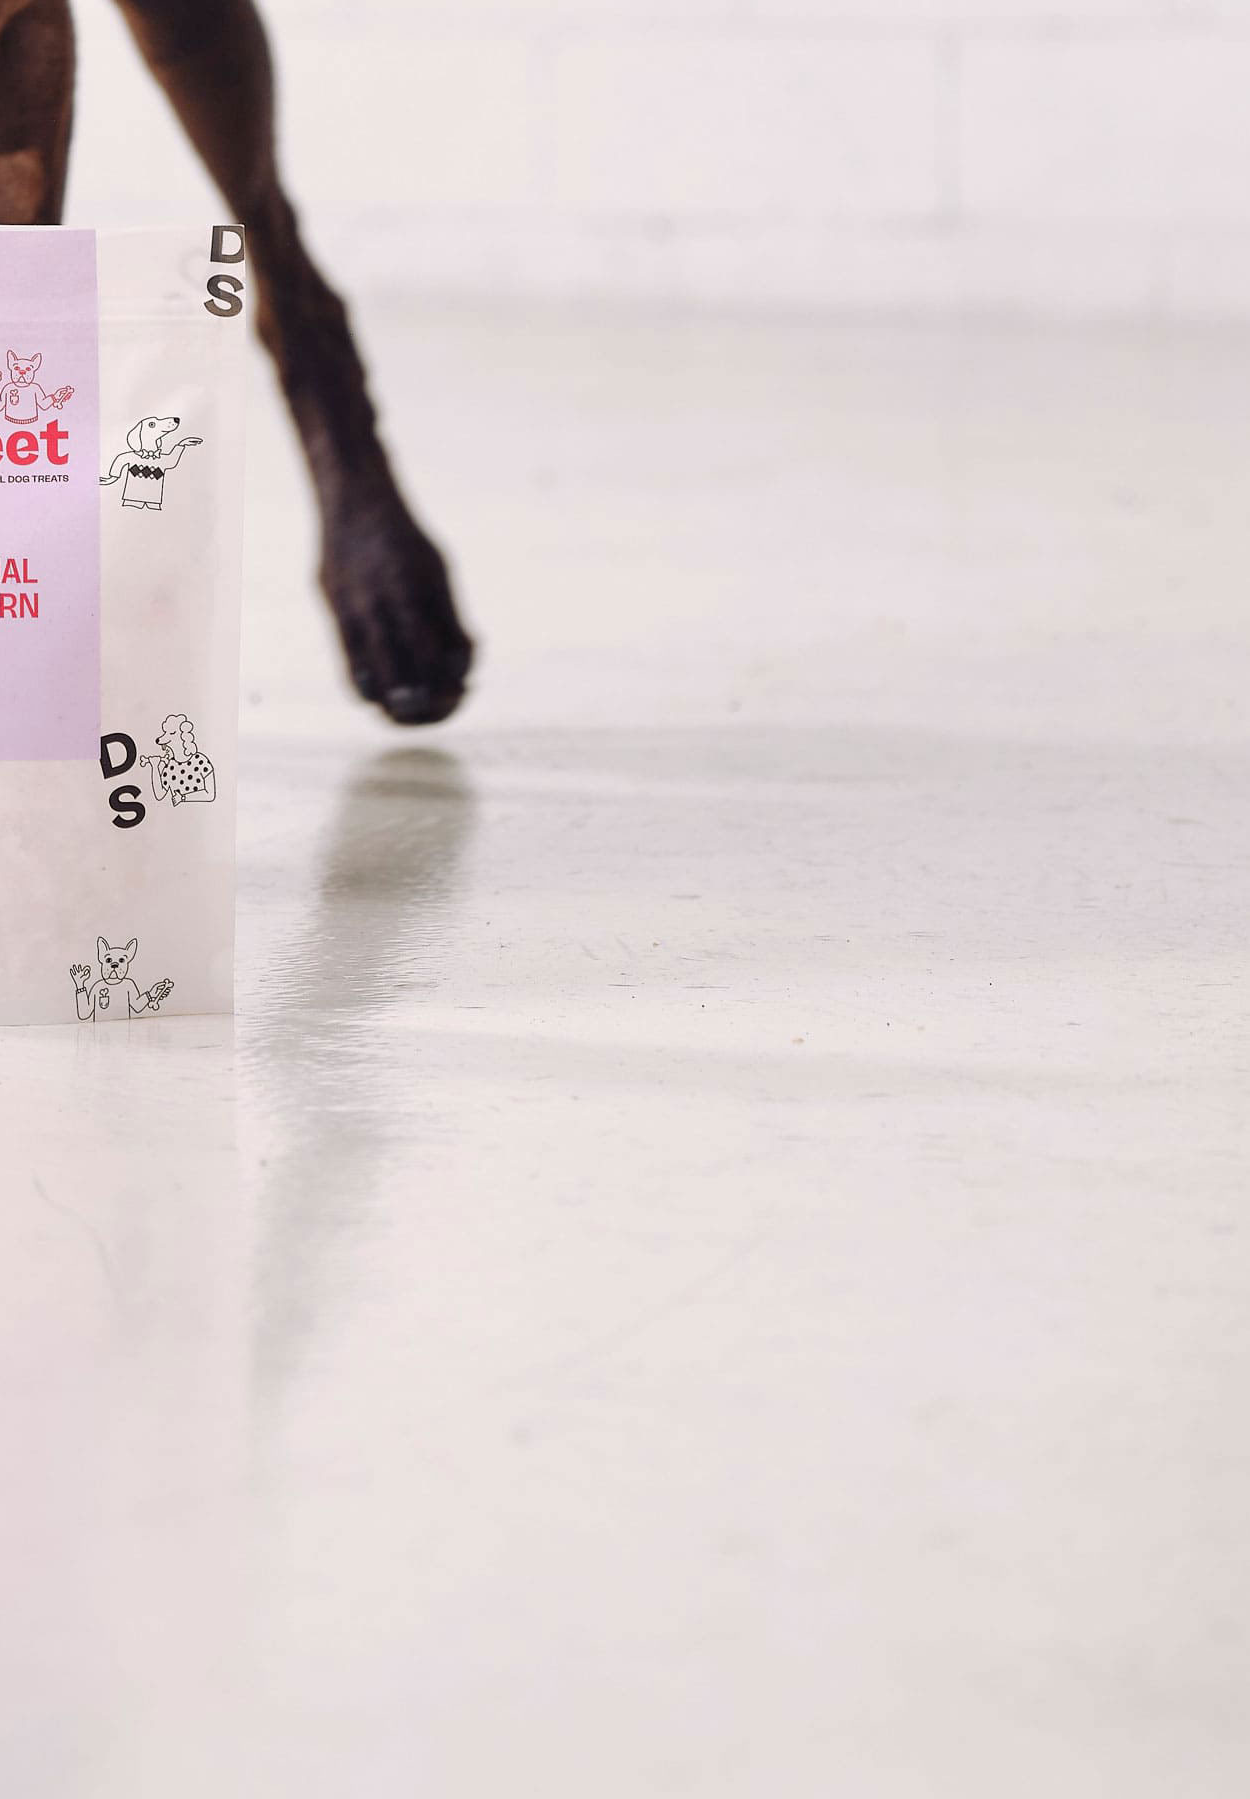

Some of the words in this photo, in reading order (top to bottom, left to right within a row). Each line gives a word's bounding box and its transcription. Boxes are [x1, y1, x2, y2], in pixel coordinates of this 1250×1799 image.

[210, 225, 245, 263] D
[204, 274, 245, 318] S
[7, 474, 30, 484] DOG
[31, 474, 70, 483] TREATS
[99, 732, 137, 779] D
[108, 785, 146, 828] S
